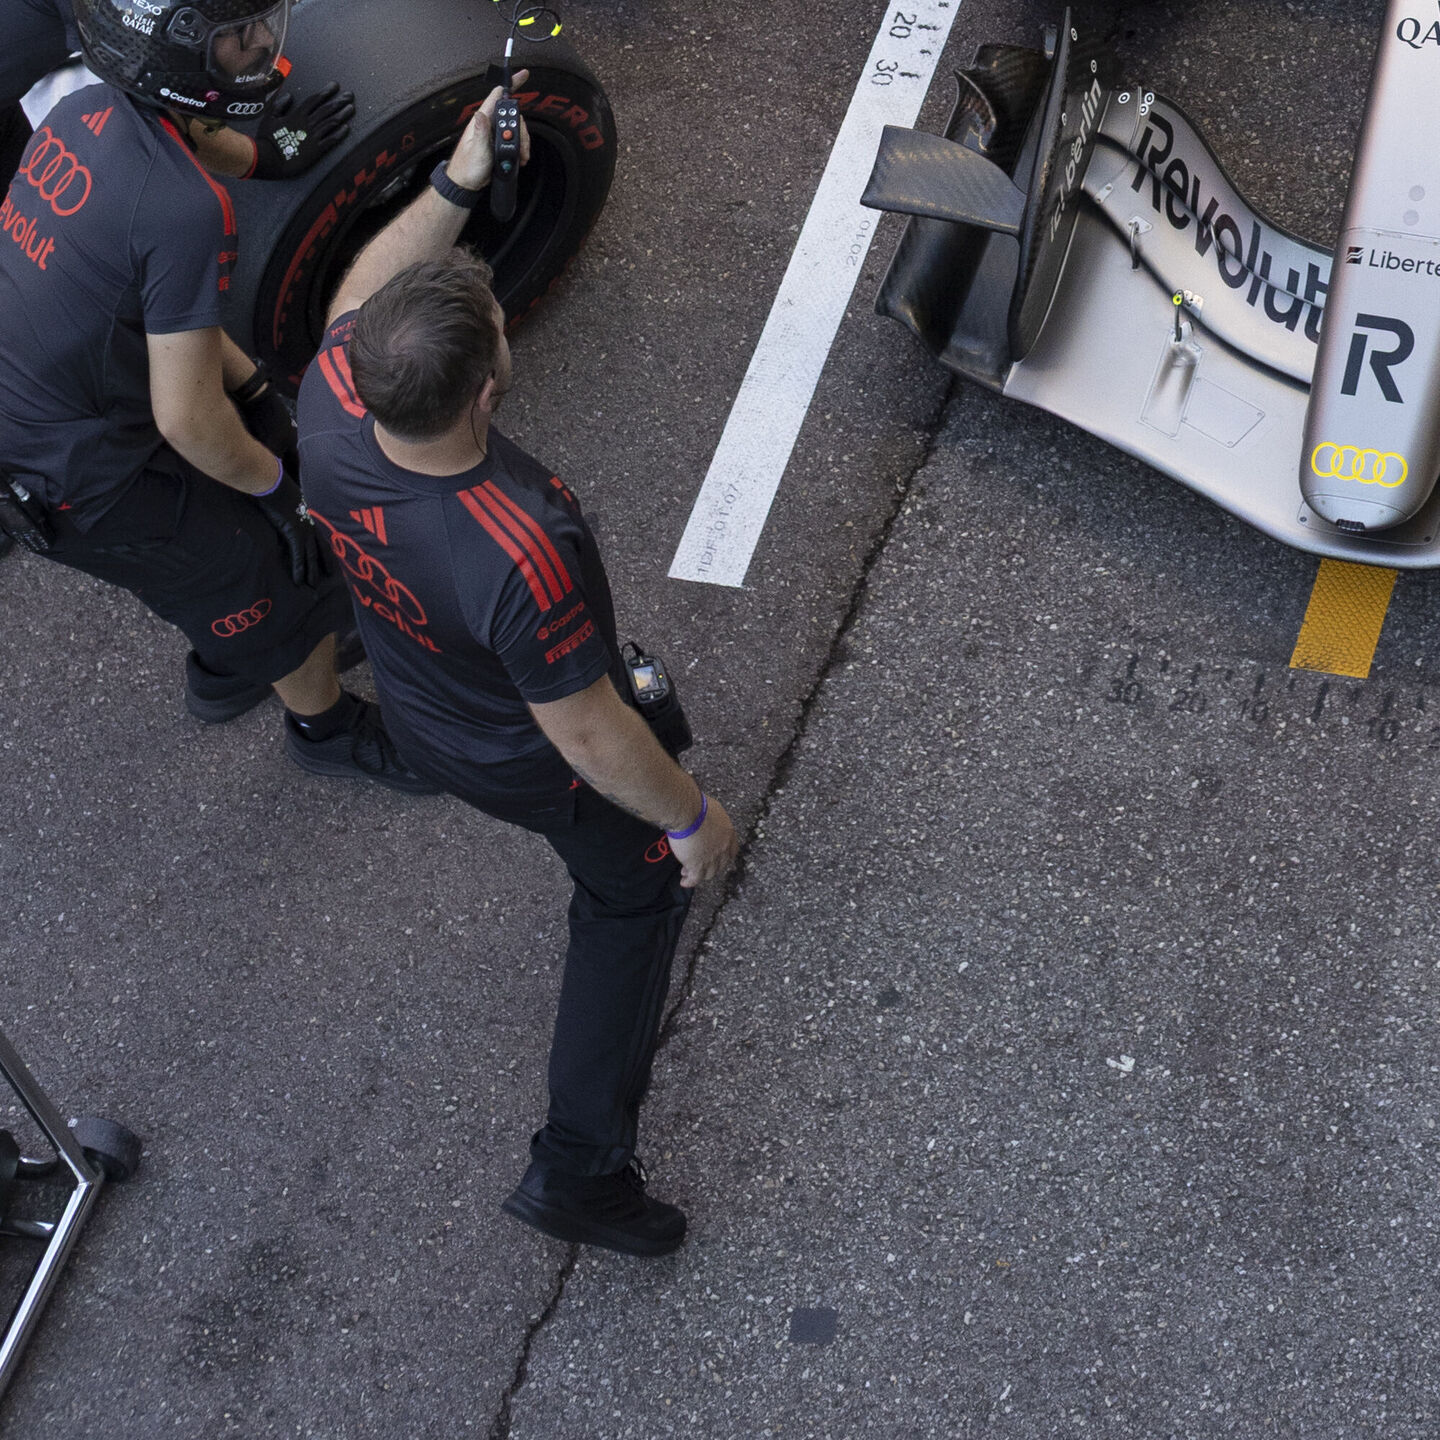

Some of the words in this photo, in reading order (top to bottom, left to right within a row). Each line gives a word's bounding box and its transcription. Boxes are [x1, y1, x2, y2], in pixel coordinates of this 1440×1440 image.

[122, 15, 153, 36] QATAR
[889, 11, 917, 38] 20
[871, 59, 899, 86] 30
[169, 91, 207, 109] Castrol
[1131, 111, 1332, 346] Revolut
[846, 220, 871, 266] 2010
